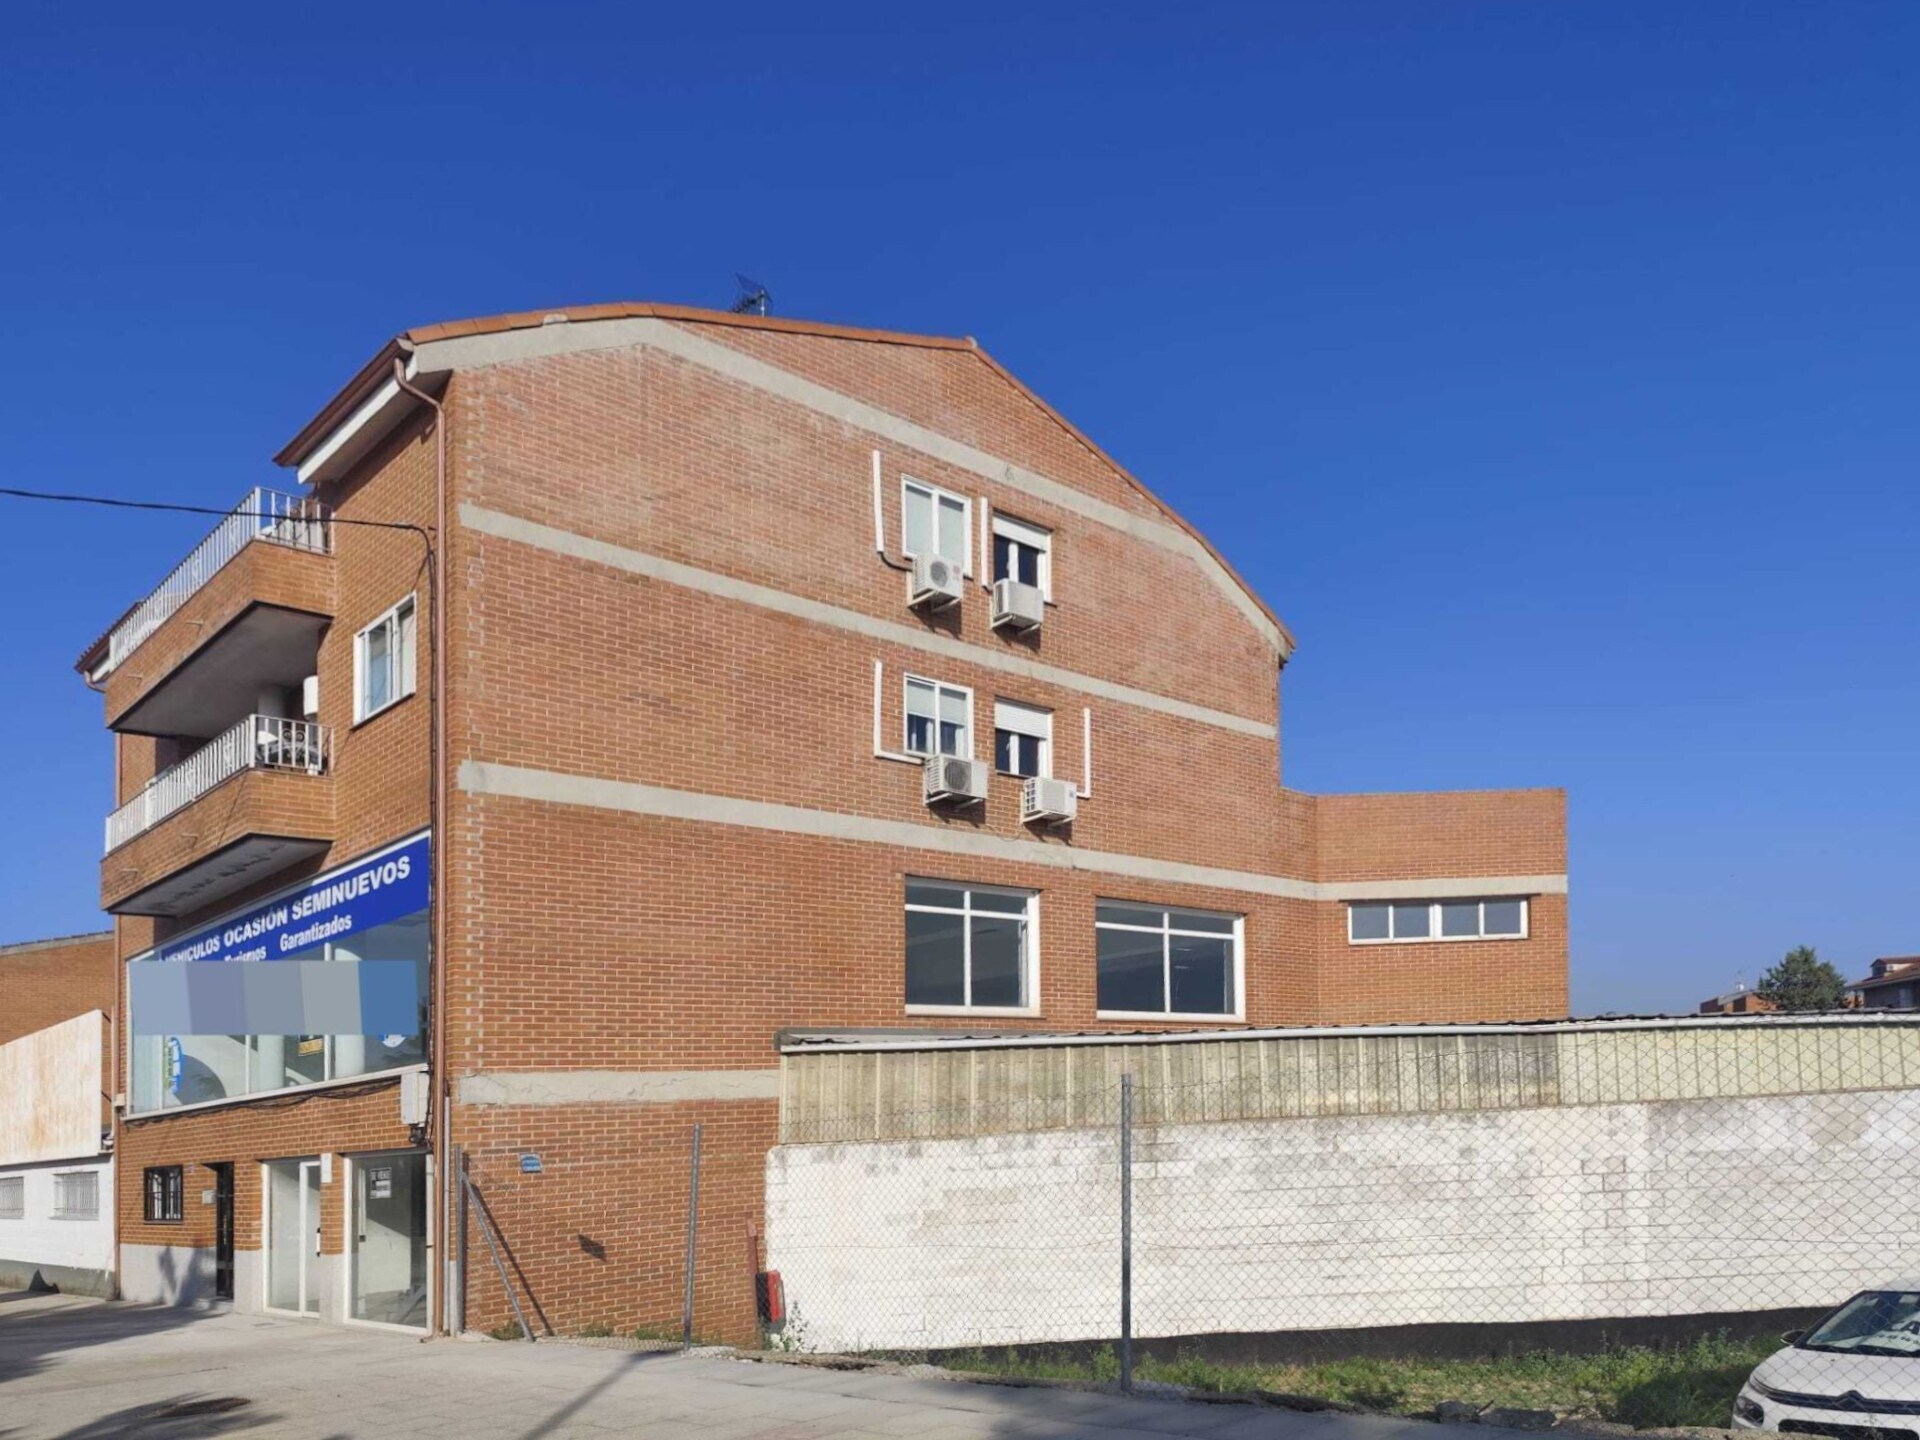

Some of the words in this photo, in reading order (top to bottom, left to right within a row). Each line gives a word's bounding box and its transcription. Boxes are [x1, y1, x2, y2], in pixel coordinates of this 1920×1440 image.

[165, 934, 220, 961] EHÍCULOS
[224, 904, 288, 947] OCASIÓN
[291, 855, 411, 920] SEMINUEVOS
[280, 914, 352, 952] Garantizados
